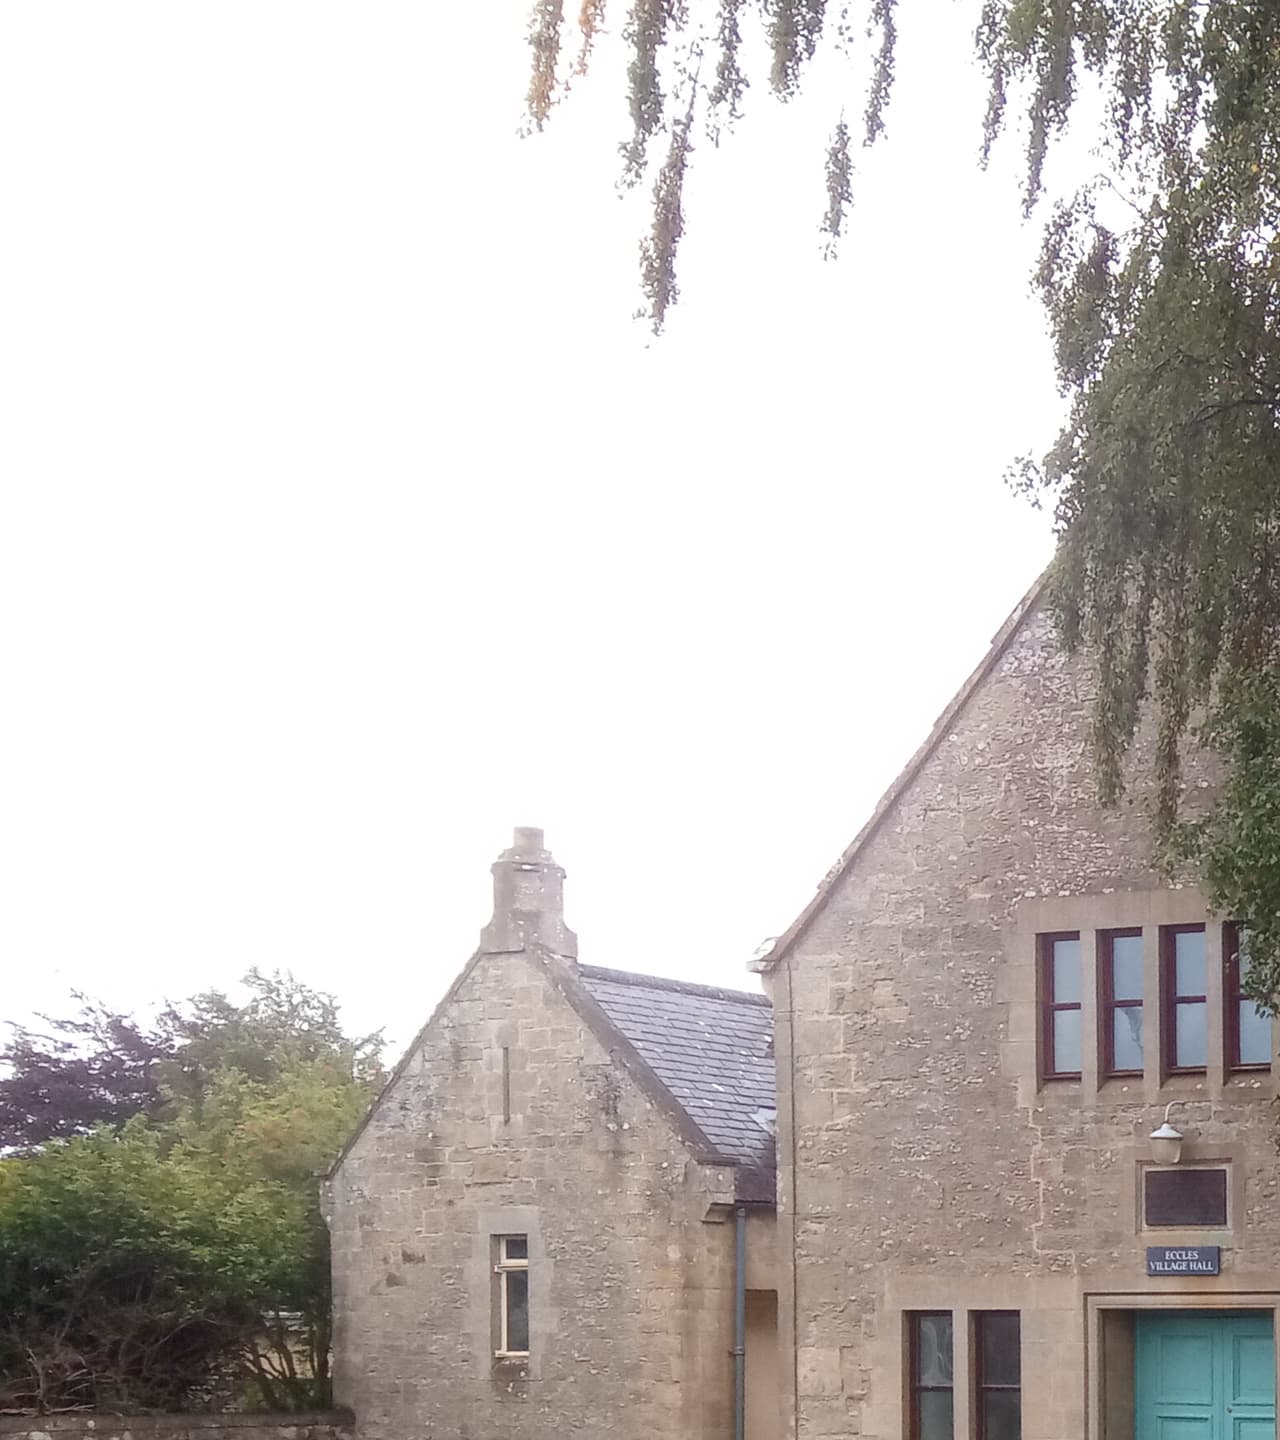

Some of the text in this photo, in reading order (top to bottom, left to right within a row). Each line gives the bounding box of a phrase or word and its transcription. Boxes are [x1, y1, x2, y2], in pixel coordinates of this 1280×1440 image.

[1165, 1250, 1199, 1260] ECCLES
[1150, 1261, 1213, 1270] VILLAGE HALL
